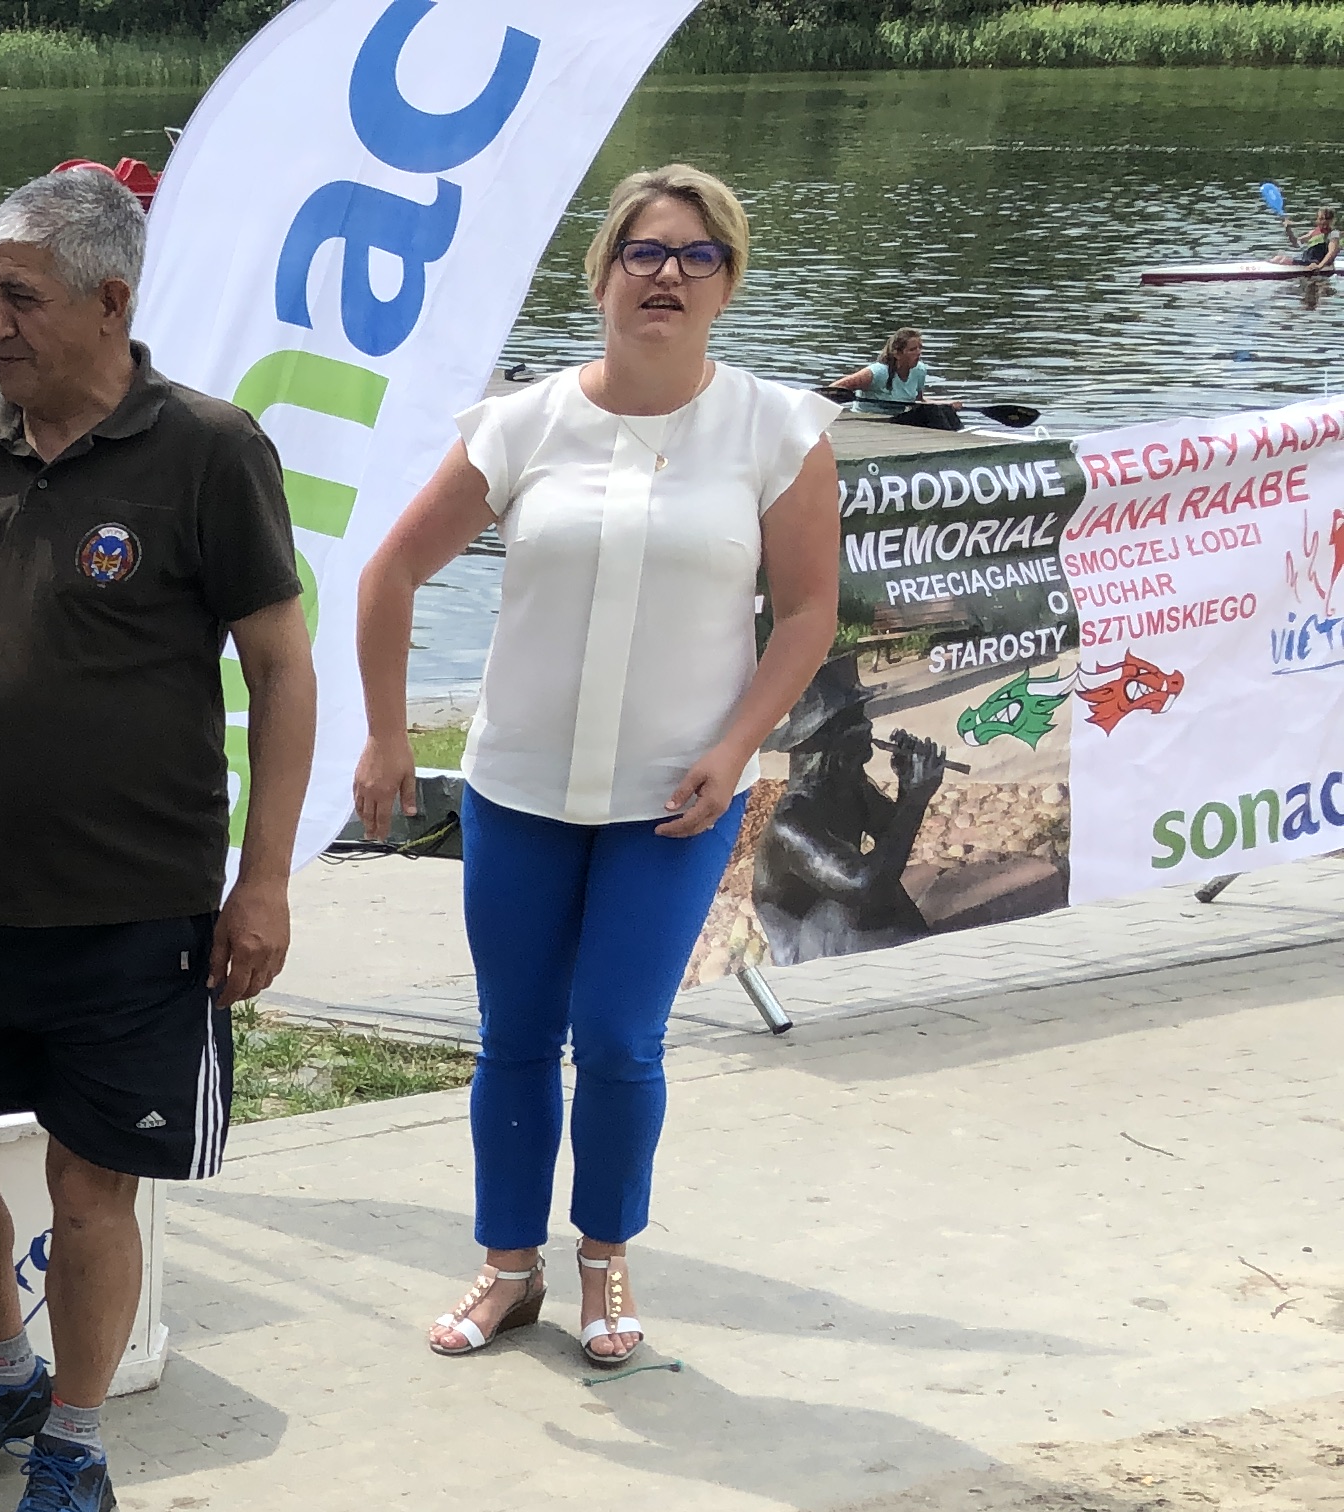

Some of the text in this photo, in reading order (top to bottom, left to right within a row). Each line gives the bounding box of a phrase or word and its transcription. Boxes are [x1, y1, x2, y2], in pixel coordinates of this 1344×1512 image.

[1082, 433, 1239, 490] REGATY
[1249, 410, 1344, 461] KAJA
[845, 464, 1311, 574] MEMORIAŁ JANA RAABE
[886, 522, 1262, 606] PRZECIĄGANIE SMOCZEJ ŁODZI
[1047, 573, 1177, 615] O PUCHAR
[928, 593, 1257, 673] STAROSTY SZTUMSKIEGO
[1151, 771, 1344, 869] sonac
